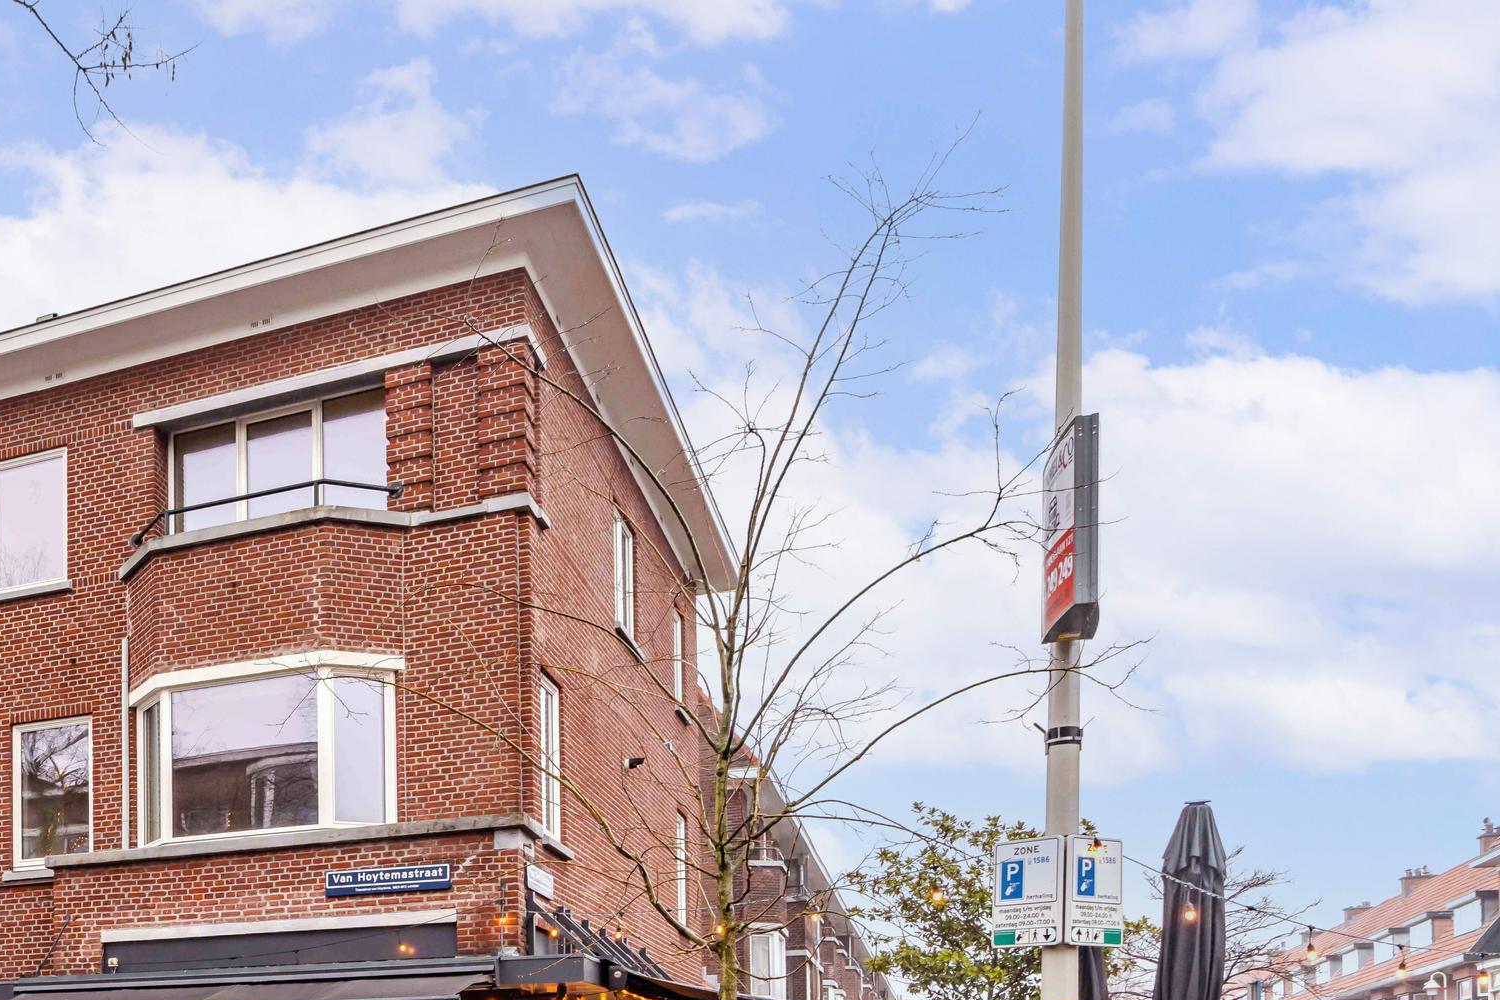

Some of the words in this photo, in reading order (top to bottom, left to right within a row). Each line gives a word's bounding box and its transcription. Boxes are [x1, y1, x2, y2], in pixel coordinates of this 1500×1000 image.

[1014, 845, 1040, 856] ZONE
[1087, 844, 1108, 854] ZE
[1033, 856, 1050, 864] 1586
[1007, 863, 1019, 881] P
[1082, 859, 1092, 877] P
[332, 874, 353, 883] Van
[357, 867, 443, 883] Hoytemastraat
